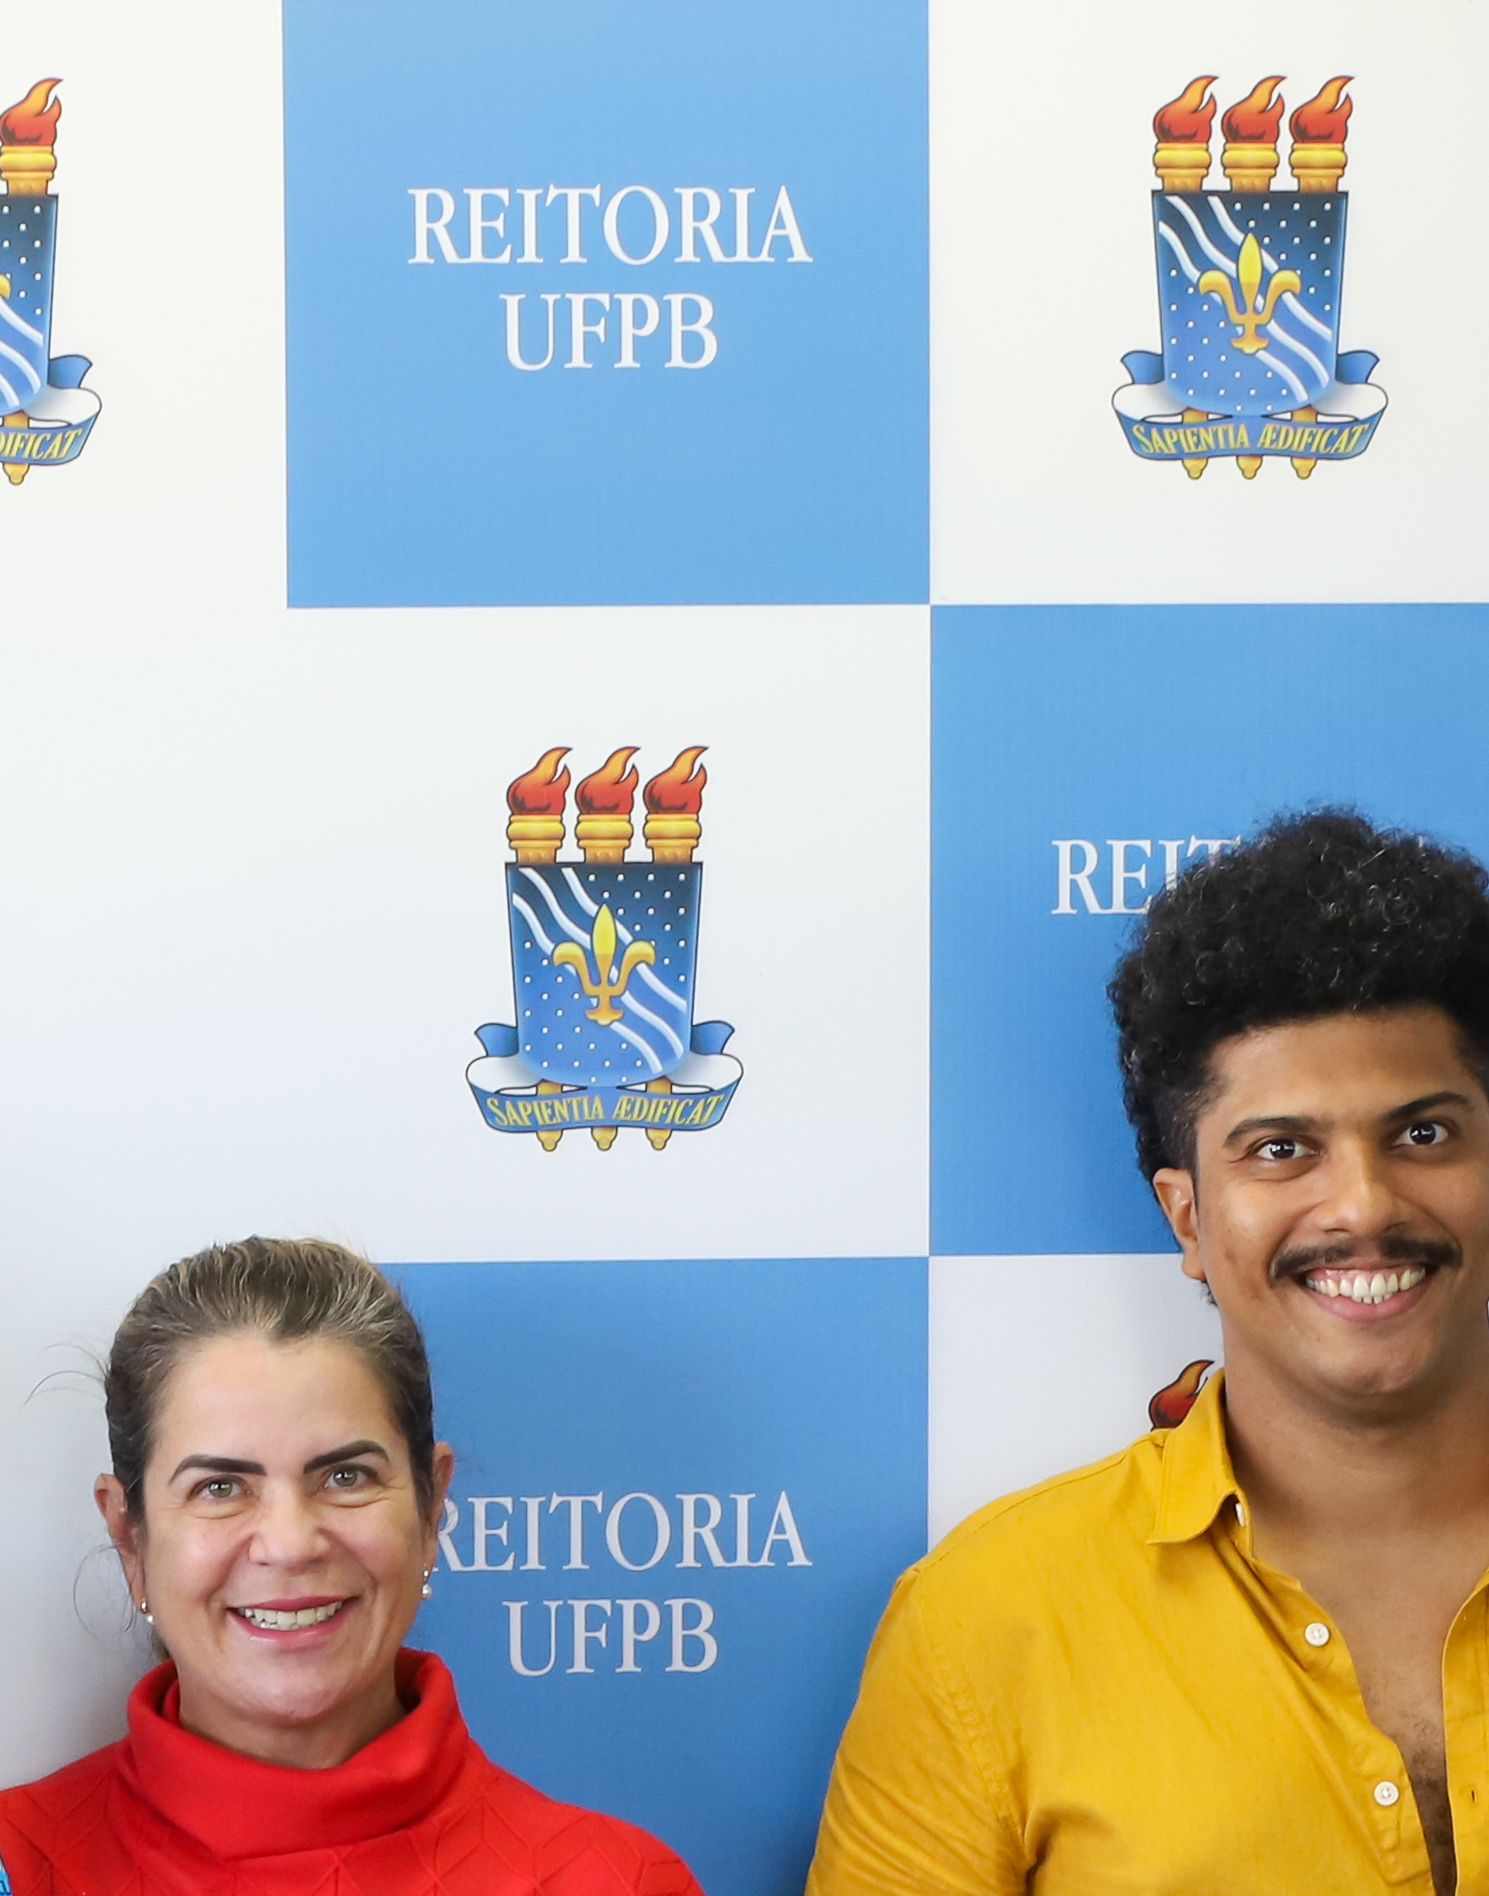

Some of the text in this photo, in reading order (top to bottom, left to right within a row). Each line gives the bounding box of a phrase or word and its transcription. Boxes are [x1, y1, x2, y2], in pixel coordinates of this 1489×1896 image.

[408, 184, 813, 265] REITORIA
[500, 293, 717, 370] UFPB
[1132, 423, 1250, 455] SAPIENTIA
[486, 1095, 605, 1126] SAPIENTIA
[501, 1598, 719, 1677] UFPB
